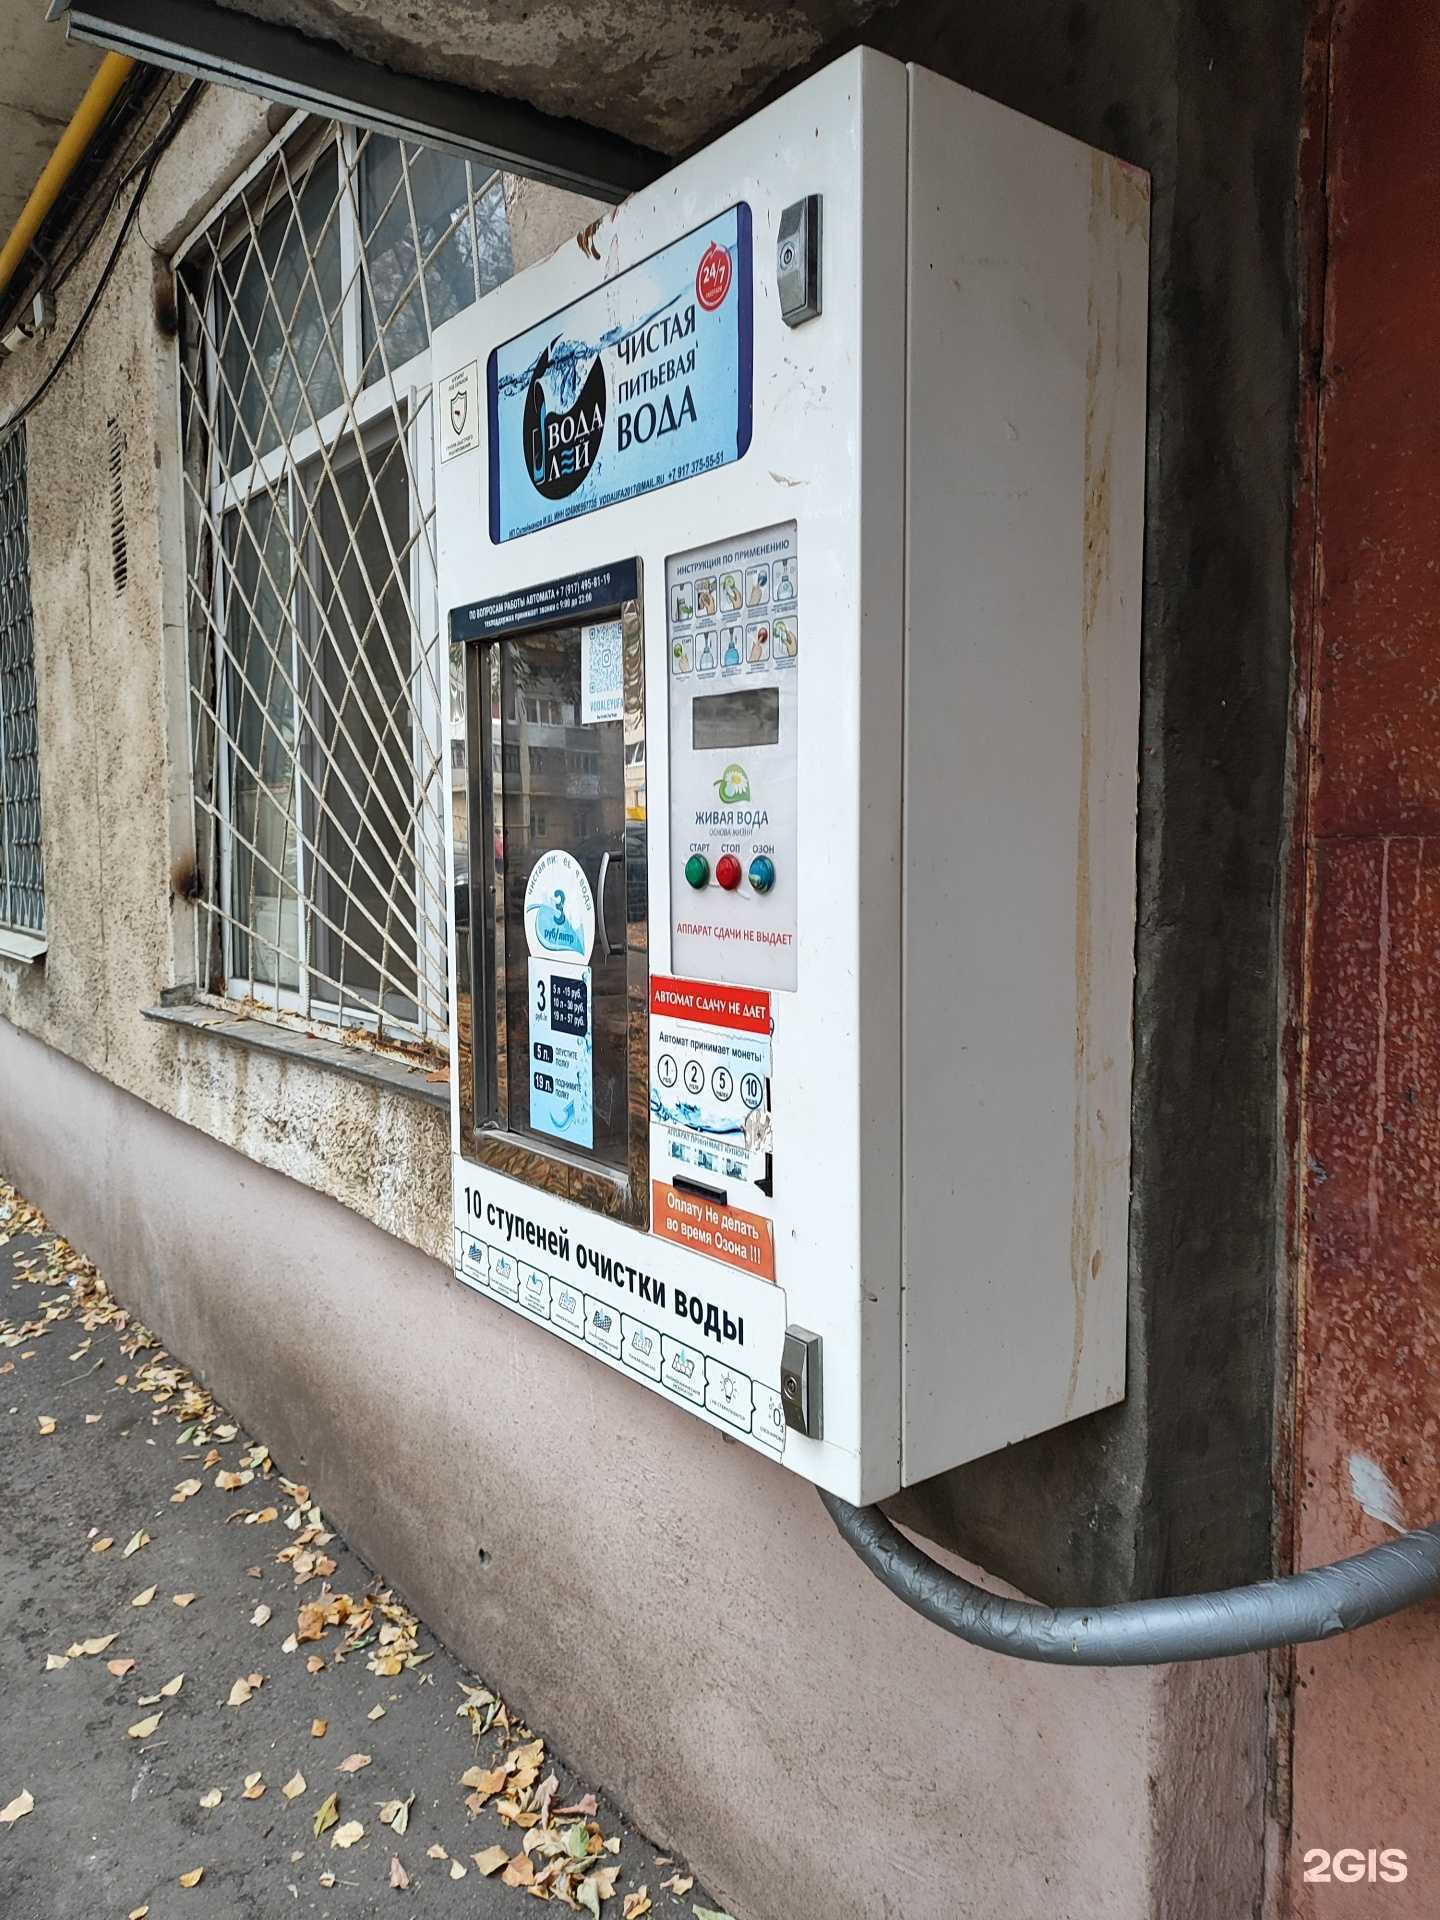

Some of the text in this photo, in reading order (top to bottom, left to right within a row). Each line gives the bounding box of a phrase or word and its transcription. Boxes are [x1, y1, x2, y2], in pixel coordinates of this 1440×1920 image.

[703, 259, 725, 287] 24/7
[617, 304, 696, 365] ЧИСТАЯ
[618, 348, 695, 404] ПИТЬЕВАЯ
[548, 402, 605, 450] ВОДА
[617, 384, 698, 453] ВОДА
[678, 463, 690, 478] 917
[677, 540, 790, 576] ИНСТРУКЦИЯ ПО ПРИМЕНЕНИЮ
[469, 610, 477, 620] ПО
[477, 601, 503, 619] ВОПРОСАМ
[504, 597, 526, 611] РАБОТЫ
[526, 589, 555, 606] АВТОМАТА
[565, 582, 580, 598] (917)
[581, 572, 611, 591] 495-81-19
[695, 811, 768, 829] ЖИВАЯ ВОДА
[689, 843, 710, 852] СТАРТ
[721, 844, 740, 853] СТОП
[752, 845, 775, 854] ОЗОН
[554, 889, 566, 926] 3
[544, 928, 575, 945] руб/литр
[677, 923, 792, 946] АППАРАТ СДАЧИ НЕ ВЫДАЕТ
[537, 980, 546, 1011] 3
[553, 997, 559, 1008] 10
[655, 990, 766, 1020] АВТОМАТ СДАЧУ НЕ ДАЕТ
[567, 1013, 573, 1024] 57
[537, 1044, 550, 1061] 5 л.
[555, 1047, 578, 1060] ОПУСТИТЕ
[659, 1031, 762, 1062] Автомат принимает монеты
[664, 1060, 669, 1076] 1
[691, 1065, 697, 1083] 2
[536, 1074, 552, 1092] 19 л.
[719, 1072, 726, 1089] 5
[746, 1078, 758, 1098] 10
[667, 1192, 759, 1240] Оплату Не делать
[666, 1217, 761, 1265] во время Озона !!!
[464, 1186, 744, 1346] 10 ступеней очистки воды
